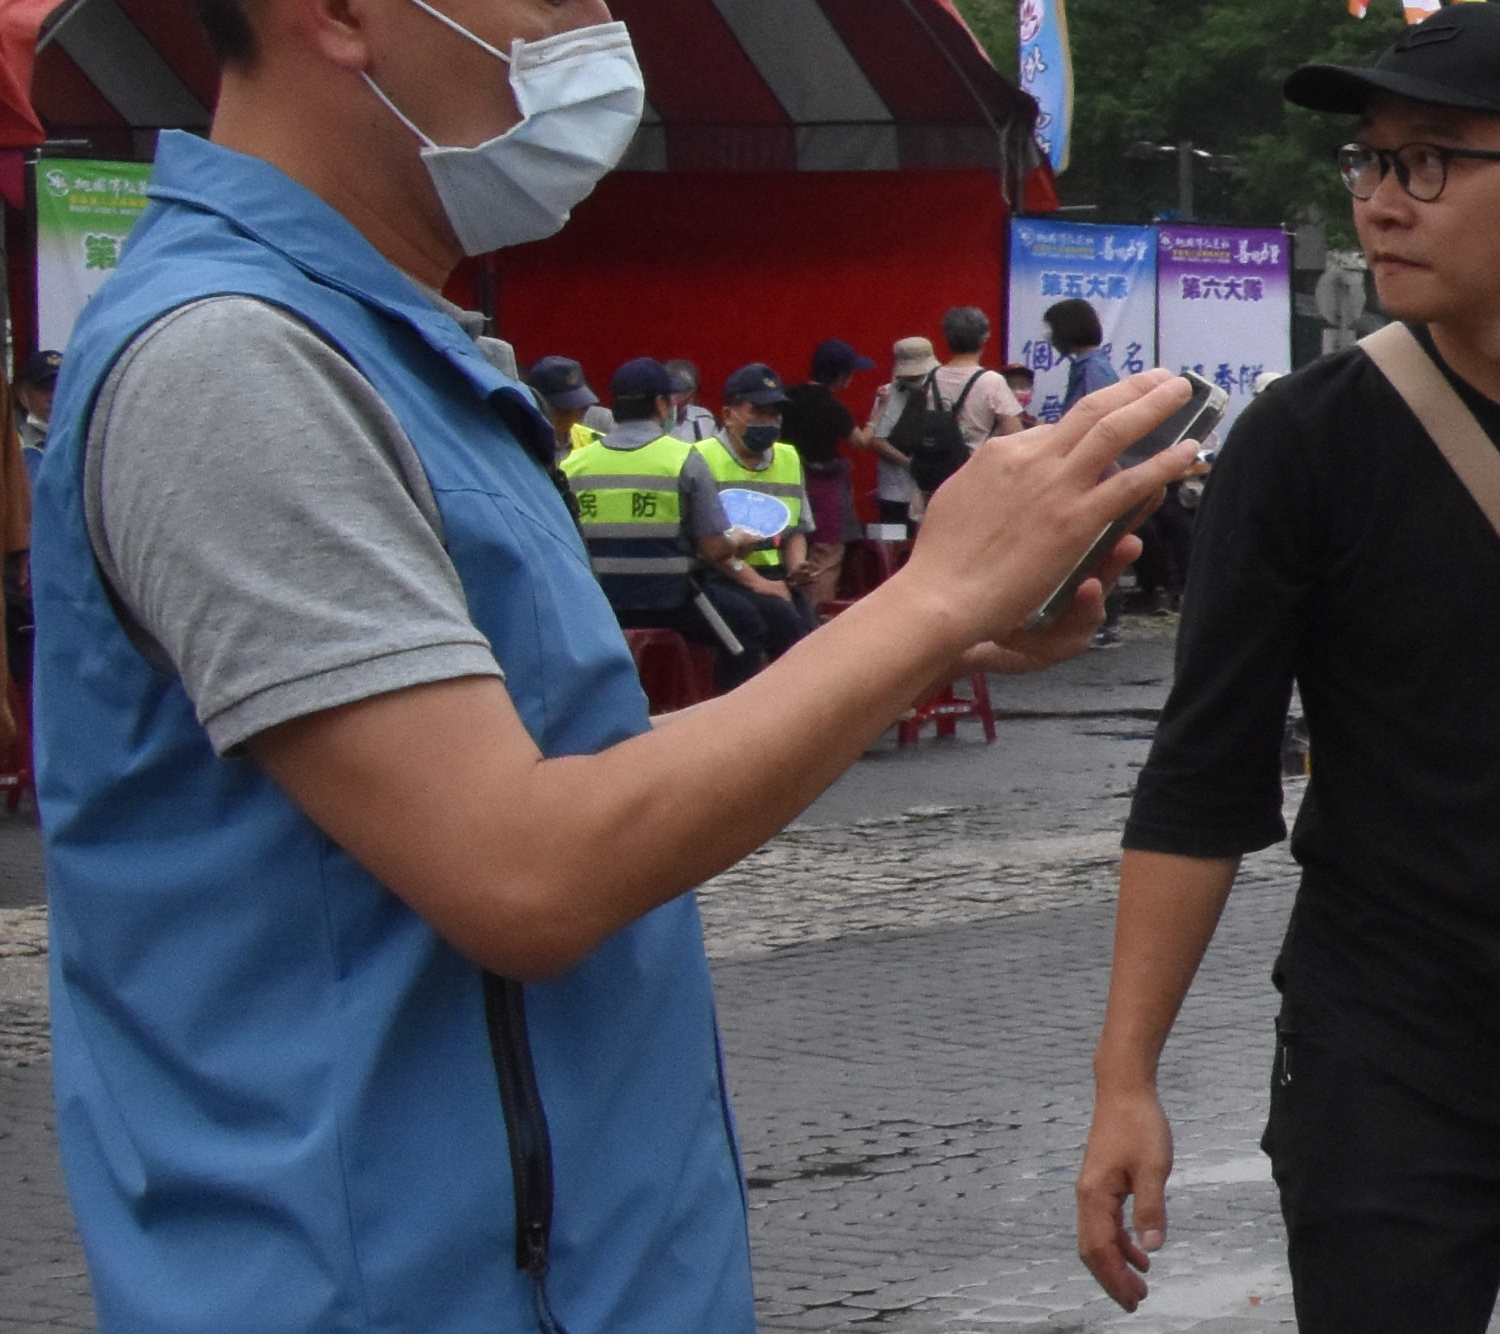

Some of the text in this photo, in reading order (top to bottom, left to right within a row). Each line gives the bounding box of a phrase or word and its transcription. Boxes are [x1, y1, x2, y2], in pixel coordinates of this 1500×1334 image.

[1040, 271, 1128, 300] 第五大隊
[1180, 275, 1264, 302] 第六大隊
